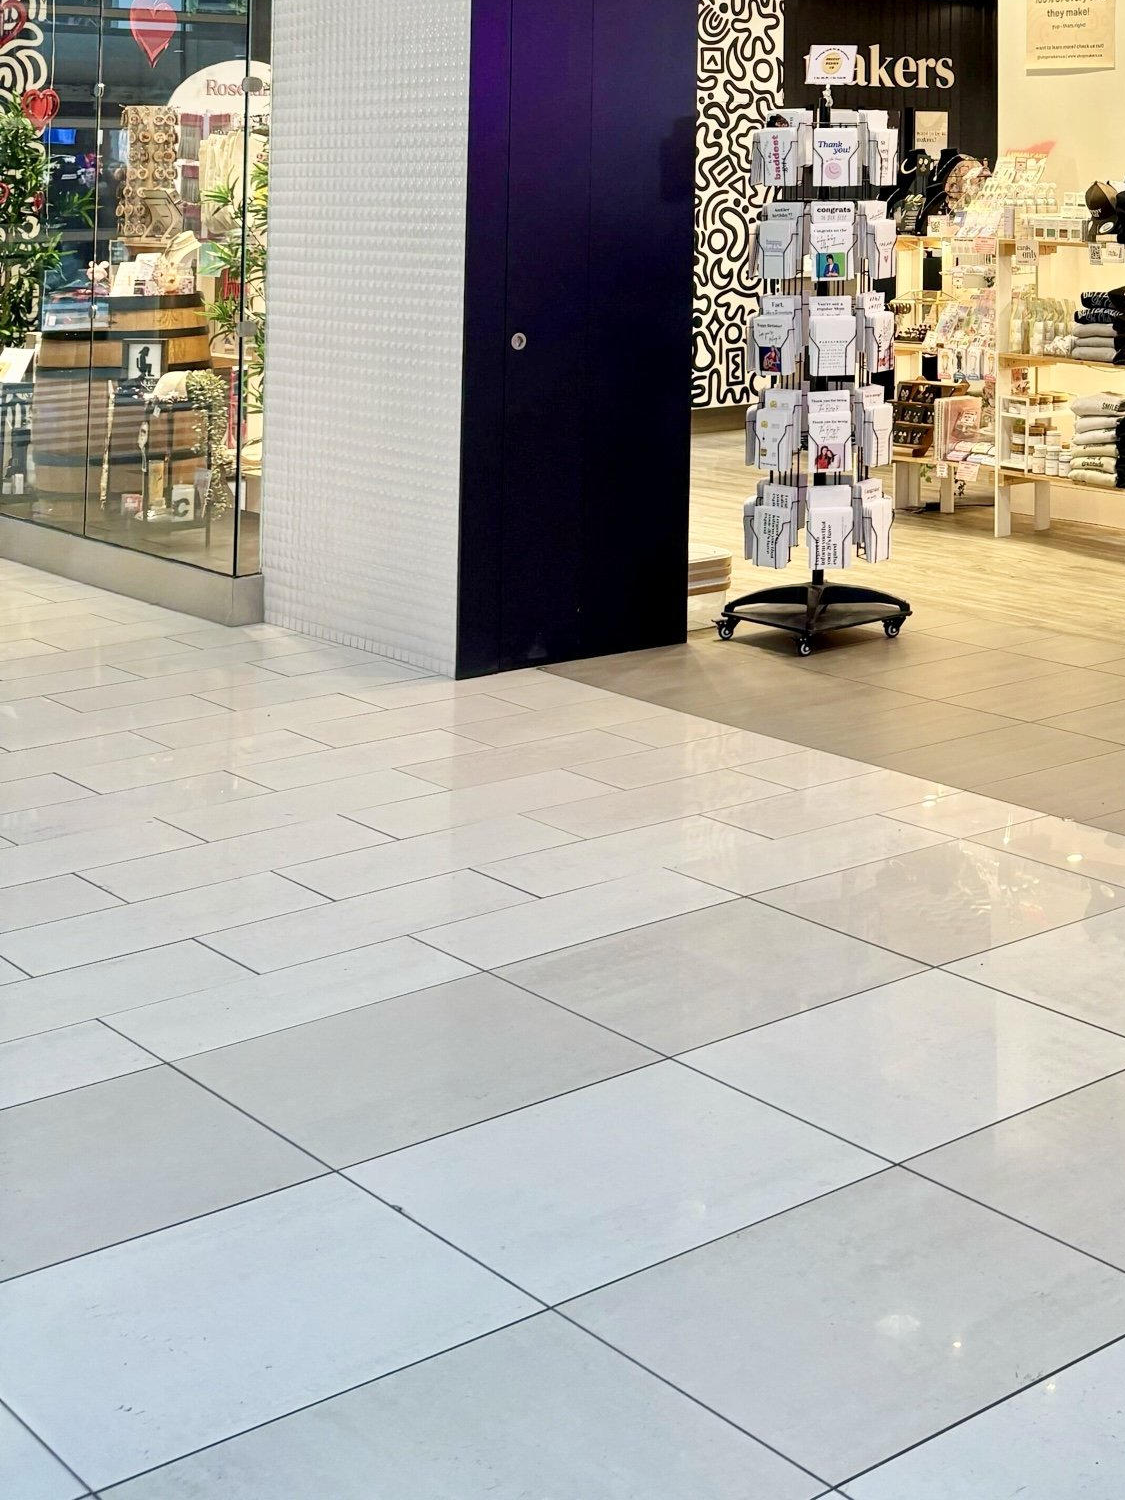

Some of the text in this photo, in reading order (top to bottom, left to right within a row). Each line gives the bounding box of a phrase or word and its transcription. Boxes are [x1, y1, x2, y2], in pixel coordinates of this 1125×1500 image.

[1047, 7, 1090, 19] they make!
[833, 147, 851, 155] you!
[817, 206, 851, 214] congrats
[1022, 250, 1037, 261] only
